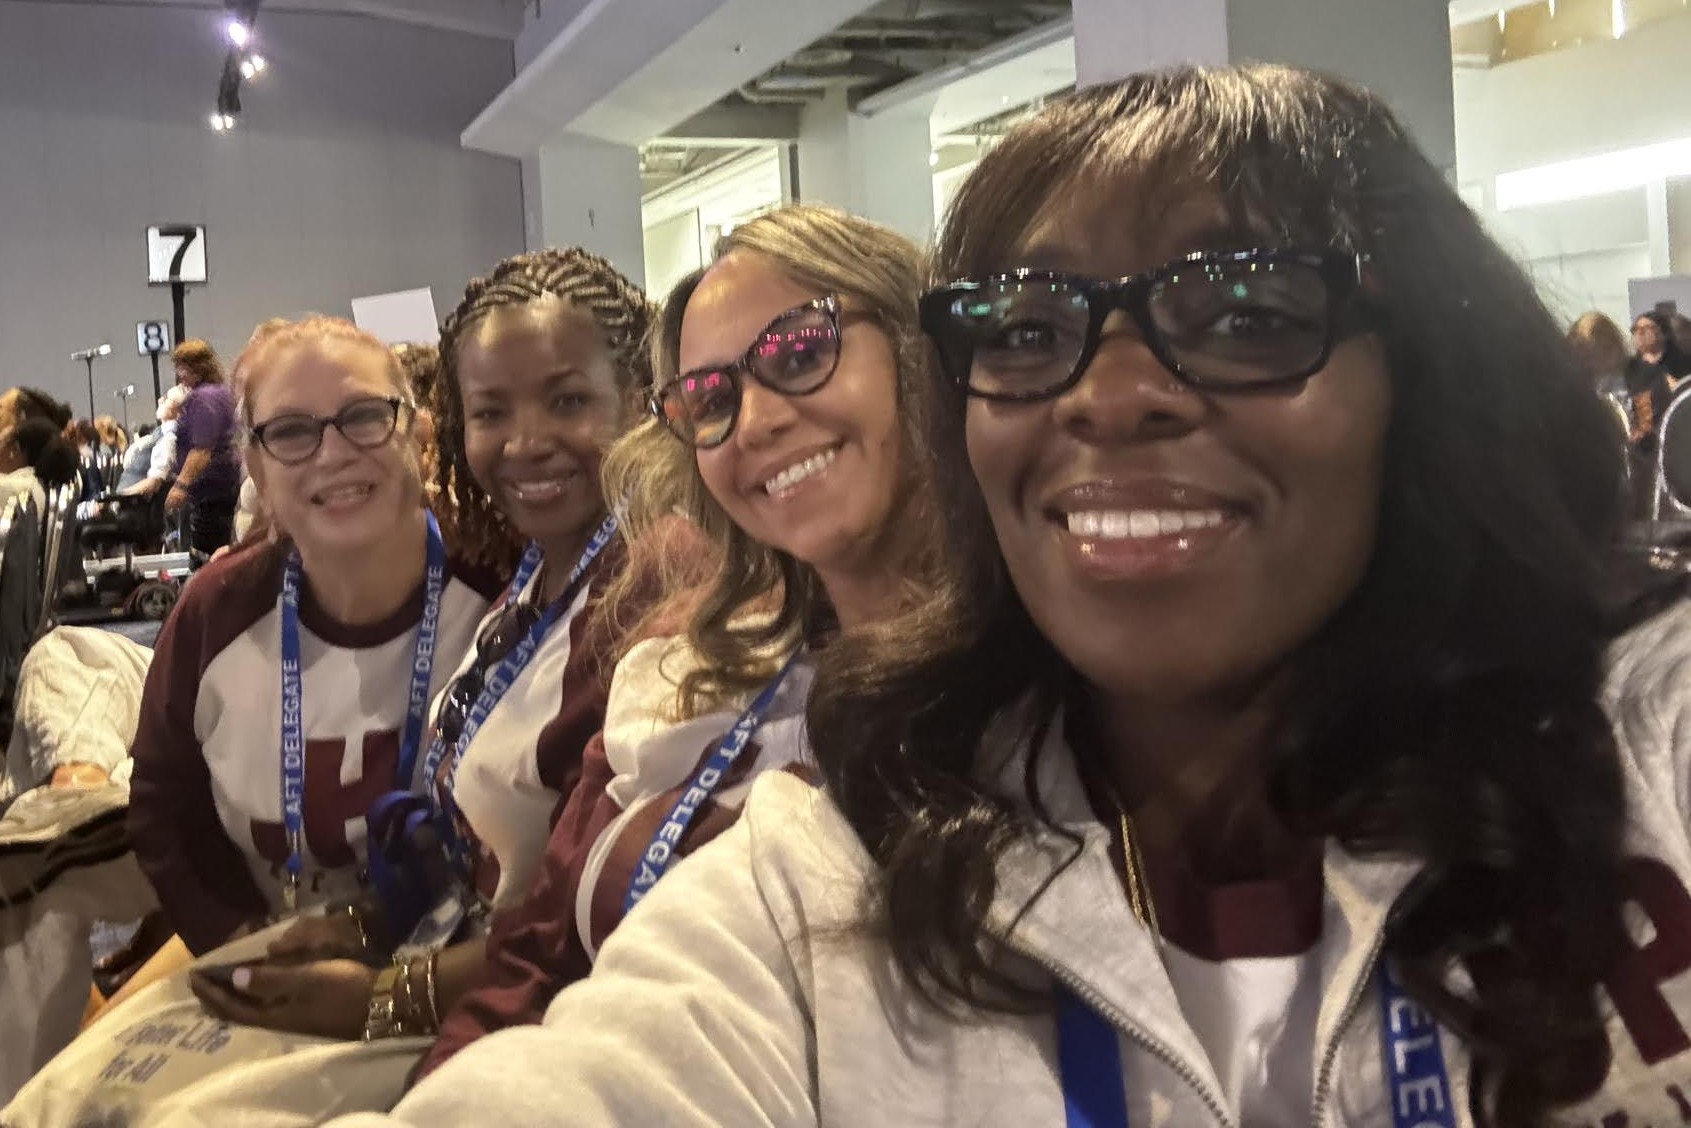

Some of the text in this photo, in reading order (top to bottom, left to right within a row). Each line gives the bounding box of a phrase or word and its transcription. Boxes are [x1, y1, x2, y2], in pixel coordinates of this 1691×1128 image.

[159, 227, 197, 281] 7
[144, 322, 164, 351] 8
[410, 565, 443, 717] AFT DELEGATE
[503, 625, 536, 680] AFT
[283, 659, 301, 815] AFT DELEGATE
[720, 714, 758, 763] AFT
